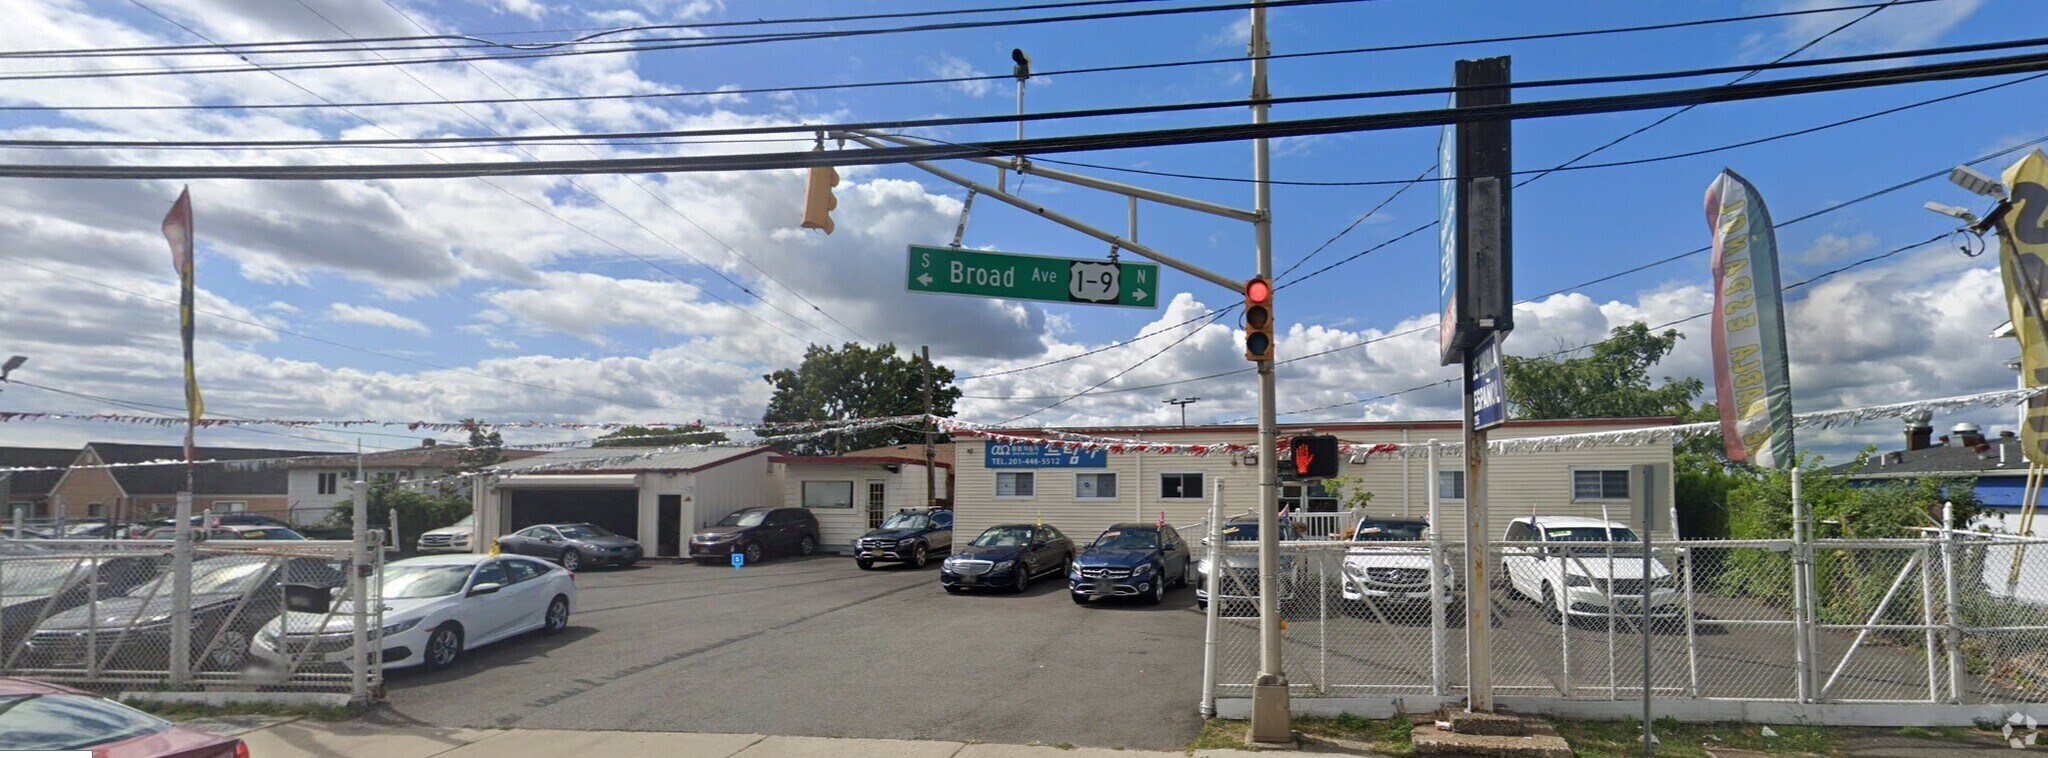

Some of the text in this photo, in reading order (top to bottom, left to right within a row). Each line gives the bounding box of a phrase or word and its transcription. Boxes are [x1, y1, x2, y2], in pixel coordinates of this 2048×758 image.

[921, 253, 1146, 294] S Broad Ave 1-9 N
[992, 457, 1008, 465] TEL.
